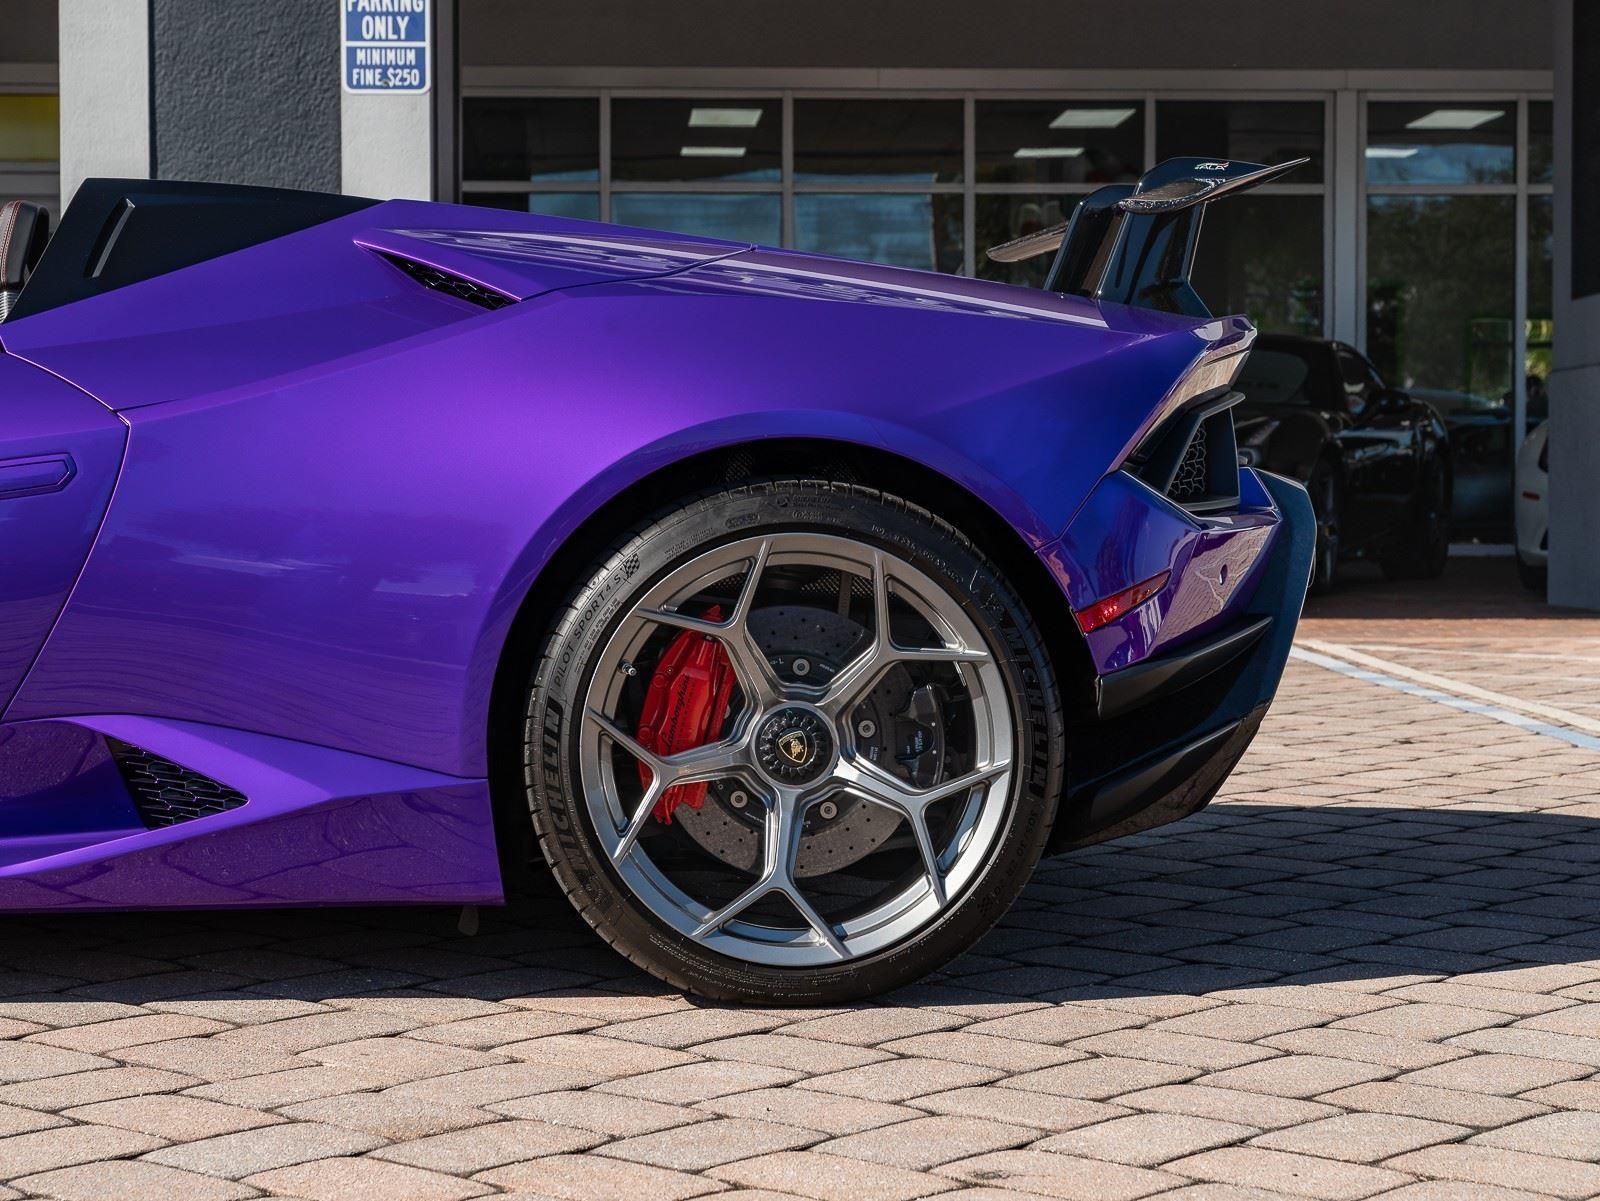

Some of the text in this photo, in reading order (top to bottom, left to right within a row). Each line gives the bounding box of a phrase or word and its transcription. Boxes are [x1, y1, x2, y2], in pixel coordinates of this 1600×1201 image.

[361, 15, 410, 40] ONLY
[356, 48, 416, 66] MINIMUM
[352, 67, 420, 88] FINE $250
[605, 583, 612, 592] 4
[613, 573, 622, 585] S
[574, 590, 606, 641] SPORT
[554, 641, 575, 687] PILOT
[543, 705, 588, 871] MICHELIN
